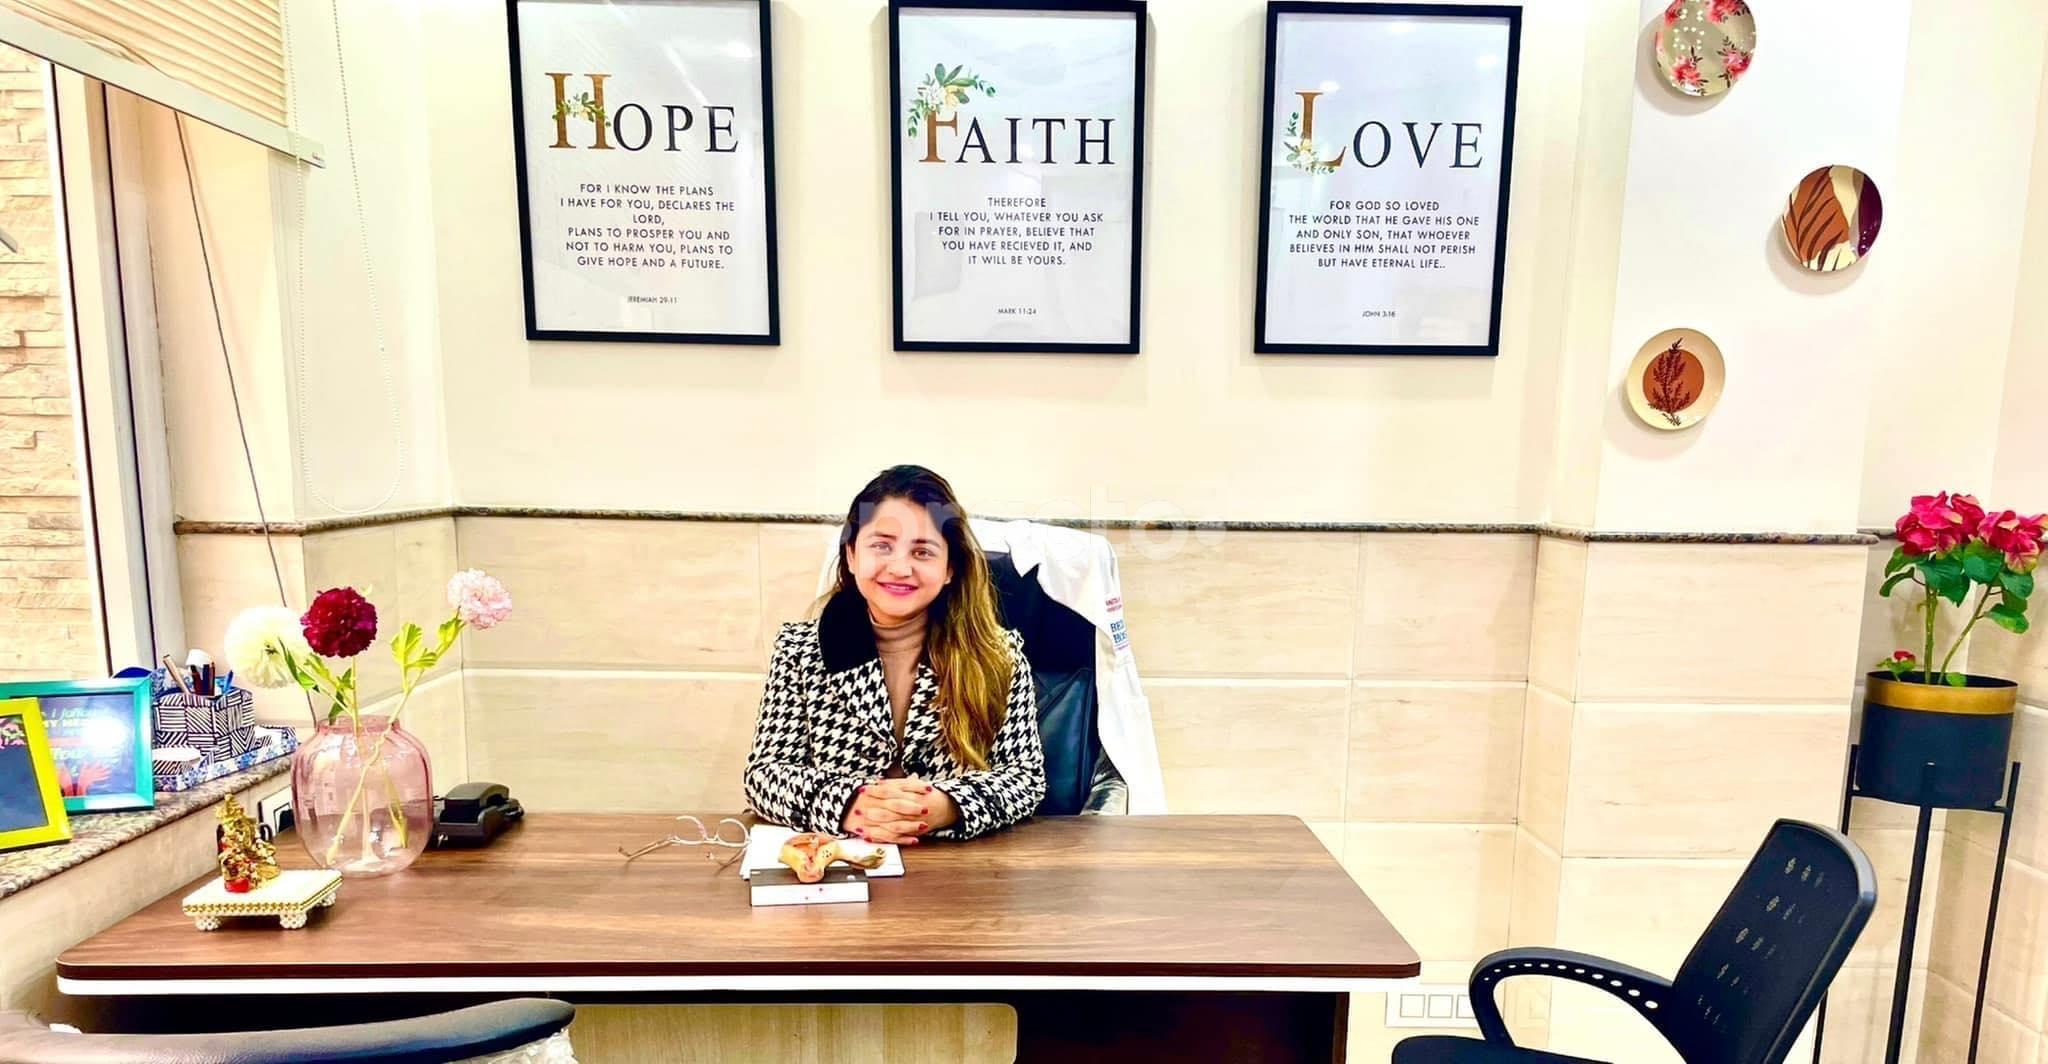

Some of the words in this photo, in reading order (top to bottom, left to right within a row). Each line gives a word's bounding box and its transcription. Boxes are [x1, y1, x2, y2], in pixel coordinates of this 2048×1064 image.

[545, 72, 739, 153] HOPE
[1295, 91, 1483, 169] LOVE
[918, 111, 1116, 165] FAITH
[580, 184, 601, 193] FOR
[615, 185, 650, 194] KNOW
[656, 186, 674, 195] THE
[680, 186, 713, 196] PLANS
[568, 198, 596, 207] HAVE
[601, 199, 622, 208] FOR
[627, 200, 654, 210] YOU,
[659, 200, 711, 210] DECLARES
[716, 202, 734, 211] THE
[988, 198, 1046, 207] THEREFORE
[1330, 201, 1351, 210] FOR
[1356, 201, 1380, 210] GOD
[1385, 201, 1400, 210] SO
[1406, 202, 1439, 210] LOVED
[633, 215, 664, 225] LORD,
[938, 212, 959, 221] TELL
[964, 212, 989, 223] YOU,
[994, 213, 1051, 221] WHATEVER
[1056, 213, 1078, 222] YOU
[1083, 213, 1103, 222] ASK
[1289, 215, 1307, 224] THE
[1312, 215, 1351, 224] WORLD
[1356, 216, 1380, 224] THAT
[1385, 216, 1397, 224] HE
[1402, 216, 1430, 225] GAVE
[1435, 216, 1452, 225] HIS
[1457, 217, 1479, 225] ONE
[568, 227, 602, 237] PLANS
[607, 228, 622, 237] TO
[626, 229, 674, 238] PROSPER
[679, 230, 702, 240] YOU
[707, 231, 729, 240] AND
[939, 227, 959, 235] FOR
[965, 227, 975, 235] IN
[980, 227, 1021, 237] PRAYER,
[1026, 227, 1065, 236] BELIEVE
[1070, 228, 1094, 236] THAT
[1296, 230, 1319, 238] AND
[1323, 230, 1351, 239] ONLY
[1356, 230, 1382, 240] SON,
[1388, 230, 1412, 239] THAT
[1418, 231, 1470, 240] WHOEVER
[566, 242, 589, 251] NOT
[594, 242, 609, 251] TO
[613, 243, 644, 252] HARM
[649, 244, 676, 255] YOU,
[681, 245, 714, 254] PLANS
[719, 245, 733, 255] TO
[942, 241, 964, 250] YOU
[969, 241, 996, 250] HAVE
[1001, 241, 1049, 251] RECIEVED
[1054, 242, 1064, 252] IT,
[1069, 242, 1092, 251] AND
[1290, 244, 1334, 253] BELIEVES
[1378, 244, 1408, 253] SHALL
[1414, 245, 1436, 254] NOT
[1441, 245, 1475, 254] PERISH
[577, 256, 603, 265] GIVE
[608, 257, 637, 267] HOPE
[642, 259, 665, 267] AND
[670, 259, 676, 267] A
[682, 259, 724, 268] FUTURE.
[969, 256, 977, 264] IT
[982, 256, 1006, 264] WILL
[1011, 256, 1022, 264] BE
[1027, 256, 1065, 265] YOURS.
[1319, 258, 1336, 267] BUT
[1341, 259, 1368, 267] HAVE
[1372, 259, 1415, 268] ETERNAL
[1420, 259, 1445, 268] LIFE..
